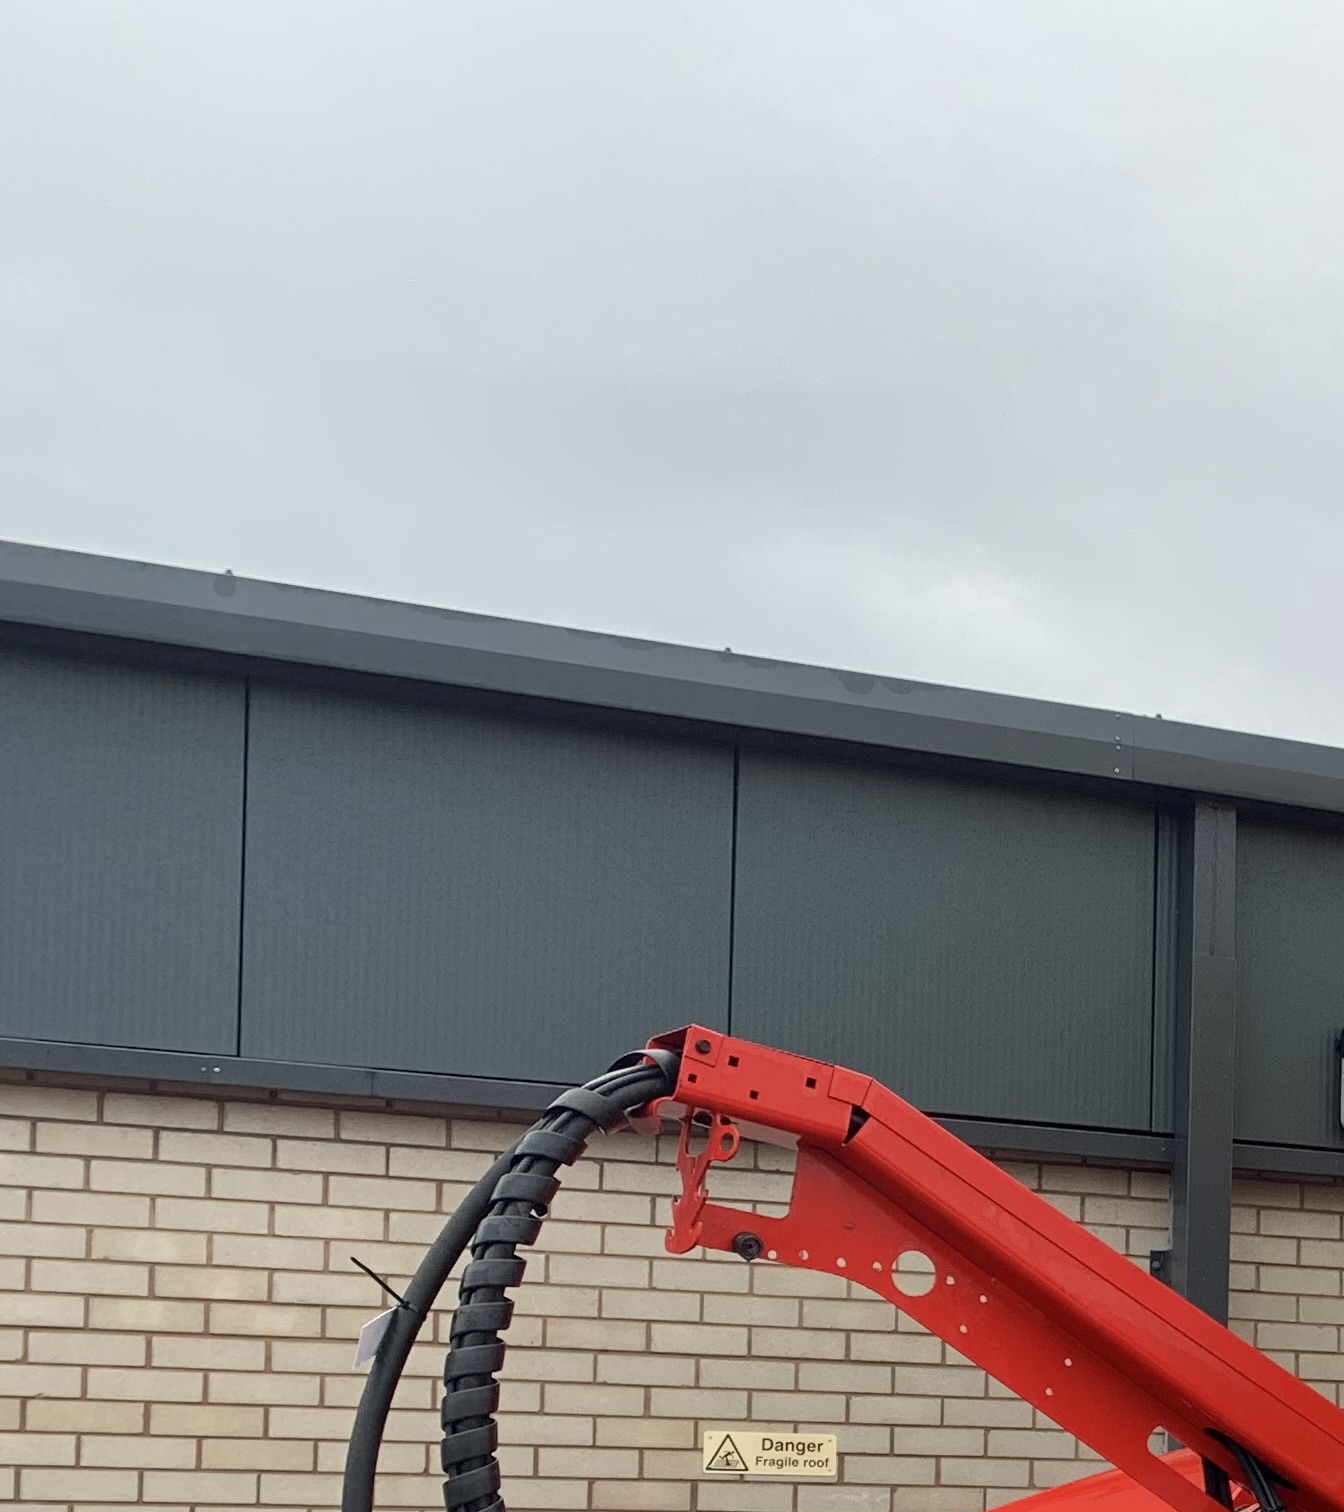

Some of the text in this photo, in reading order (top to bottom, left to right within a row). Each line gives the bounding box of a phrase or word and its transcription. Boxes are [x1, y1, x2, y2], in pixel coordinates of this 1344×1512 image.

[761, 1437, 824, 1456] Danger
[755, 1456, 830, 1469] Fragile roof
